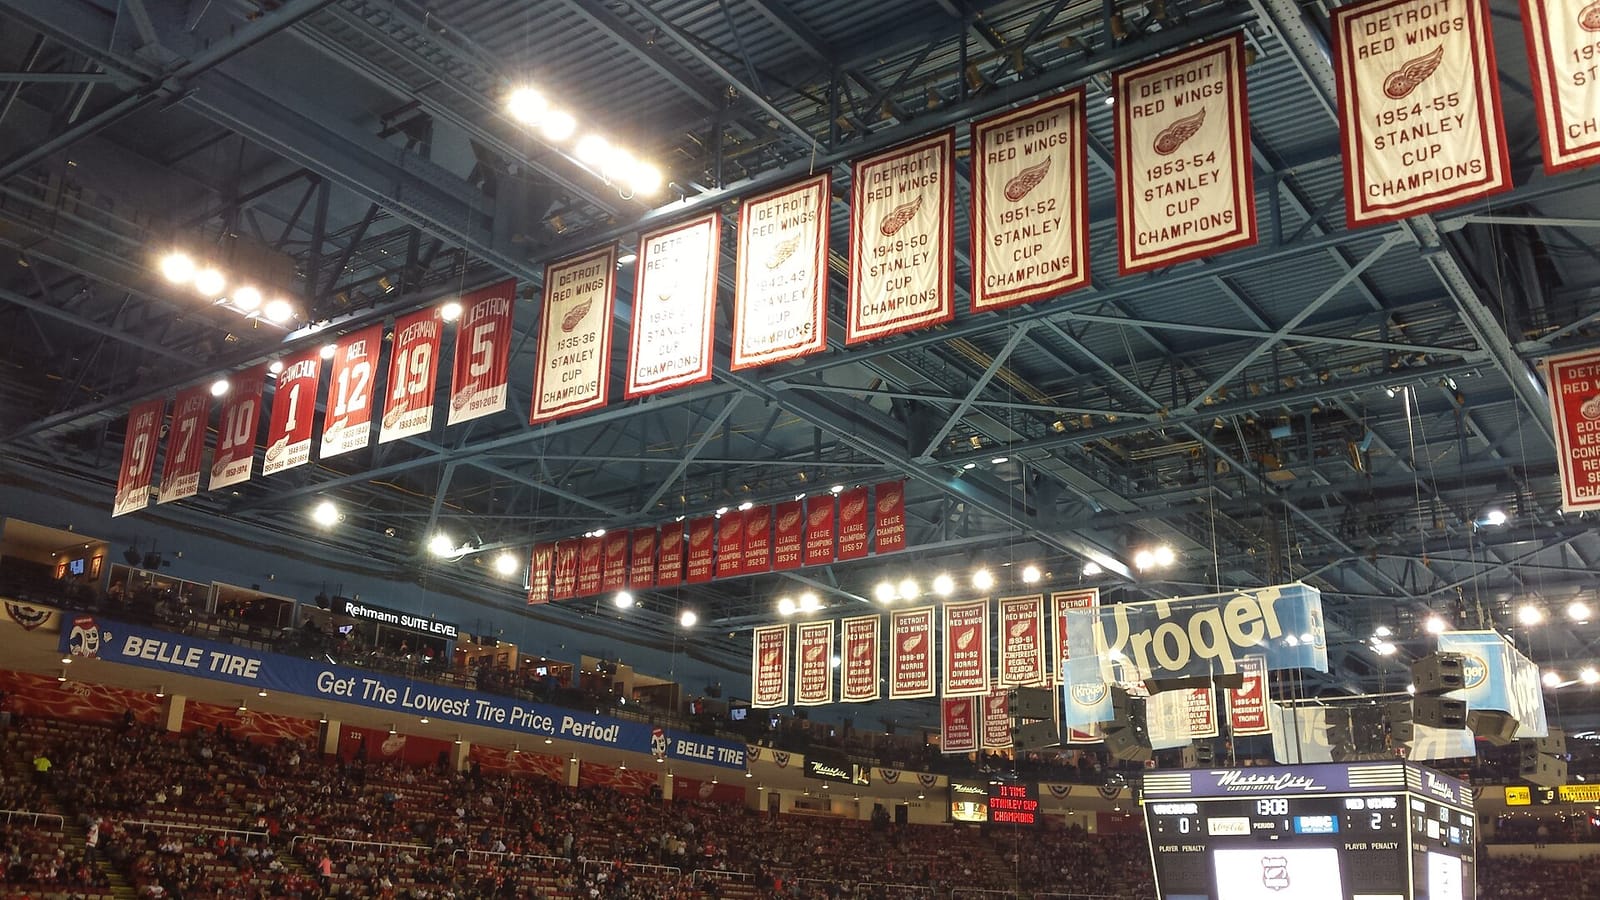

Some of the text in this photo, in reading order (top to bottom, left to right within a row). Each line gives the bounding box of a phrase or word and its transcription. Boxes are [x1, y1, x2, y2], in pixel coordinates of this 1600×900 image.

[1366, 0, 1450, 35] DETROIT
[1358, 18, 1464, 60] RED WINGS
[1141, 64, 1214, 98] DETROIT
[1133, 81, 1224, 118] RED WINGS
[1376, 92, 1459, 127] 1954-55
[996, 115, 1059, 145] DETROIT
[1375, 113, 1464, 150] STANLEY
[988, 132, 1068, 164] RED WINGS
[1402, 144, 1442, 166] CUP
[874, 156, 931, 184] DETROIT
[1147, 151, 1216, 181] 1953-54
[867, 172, 938, 203] RED WINGS
[1145, 170, 1219, 202] STANLEY
[1369, 159, 1482, 197] CHAMPIONS
[759, 195, 810, 220] DETROIT
[1000, 198, 1056, 224] 1951-52
[1166, 197, 1200, 217] CUP
[752, 211, 815, 236] RED WINGS
[994, 218, 1061, 247] STANLEY
[1138, 210, 1233, 246] CHAMPIONS
[874, 234, 928, 258] 1949-50
[1014, 244, 1042, 262] CUP
[560, 264, 602, 286] DETROIT
[871, 251, 929, 277] STANLEY
[987, 256, 1070, 288] CHAMPIONS
[552, 278, 604, 302] RED WINGS
[886, 276, 912, 292] CUP
[863, 288, 936, 316] CHAMPIONS
[399, 321, 438, 348] YZERMAN
[557, 332, 596, 350] 1935-36
[746, 322, 811, 348] CHAMPIONS
[346, 340, 367, 362] ABEL
[470, 322, 495, 377] 5
[552, 350, 594, 369] STANLEY
[280, 360, 316, 389] SAWCHUK
[393, 342, 432, 401] 19
[562, 369, 582, 383] CUP
[639, 356, 698, 378] CHAMPIONS
[334, 362, 370, 417] 12
[544, 380, 596, 403] CHAMPIONS
[1564, 381, 1589, 394] RED
[285, 384, 299, 432] 1
[470, 395, 498, 410] 1991-2012
[222, 400, 254, 450] 10
[176, 417, 197, 463] 7
[130, 433, 148, 477] 9
[844, 524, 863, 533] LEAGUE
[877, 525, 904, 536] CHAMPIONS
[880, 516, 900, 526] LEAGUE
[749, 539, 766, 548] LEAGUE
[779, 535, 797, 544] LEAGUE
[807, 539, 832, 548] CHAMPIONS
[810, 530, 829, 539] LEAGUE
[840, 532, 866, 542] CHAMPIONS
[692, 549, 709, 558] LEAGUE
[719, 552, 741, 561] CHAMPIONS
[722, 544, 738, 552] LEAGUE
[746, 548, 768, 558] CHAMPIONS
[776, 544, 800, 553] CHAMPIONS
[632, 565, 653, 574] CHAMPIONS
[635, 557, 651, 565] LEAGUE
[659, 562, 680, 570] CHAMPIONS
[688, 558, 711, 567] CHAMPIONS
[953, 609, 979, 618] DETROIT
[1008, 604, 1033, 612] DETROIT
[1061, 599, 1088, 608] DETROIT
[346, 602, 457, 637] Rehmann SUITE LEVEL
[850, 624, 872, 632] DETROIT
[964, 617, 982, 625] WINGS
[1092, 588, 1281, 684] Kroger
[123, 635, 261, 679] BELLE TIRE
[896, 680, 928, 688] CHAMPIONS
[950, 678, 982, 686] CHAMPIONS
[1006, 672, 1038, 680] CHAMPIONS
[74, 687, 90, 698] 220
[317, 671, 619, 742] Get The Lowest Tire Price, Period!
[676, 740, 744, 764] BELLE TIRE
[1001, 787, 1026, 797] 11 TIME
[990, 798, 1037, 810] STANLEY CUP
[1257, 799, 1288, 815] 13:08
[994, 811, 1034, 823] CHAMPIONS
[1180, 818, 1189, 833] 0
[1285, 820, 1289, 830] 1
[1371, 813, 1381, 829] 2
